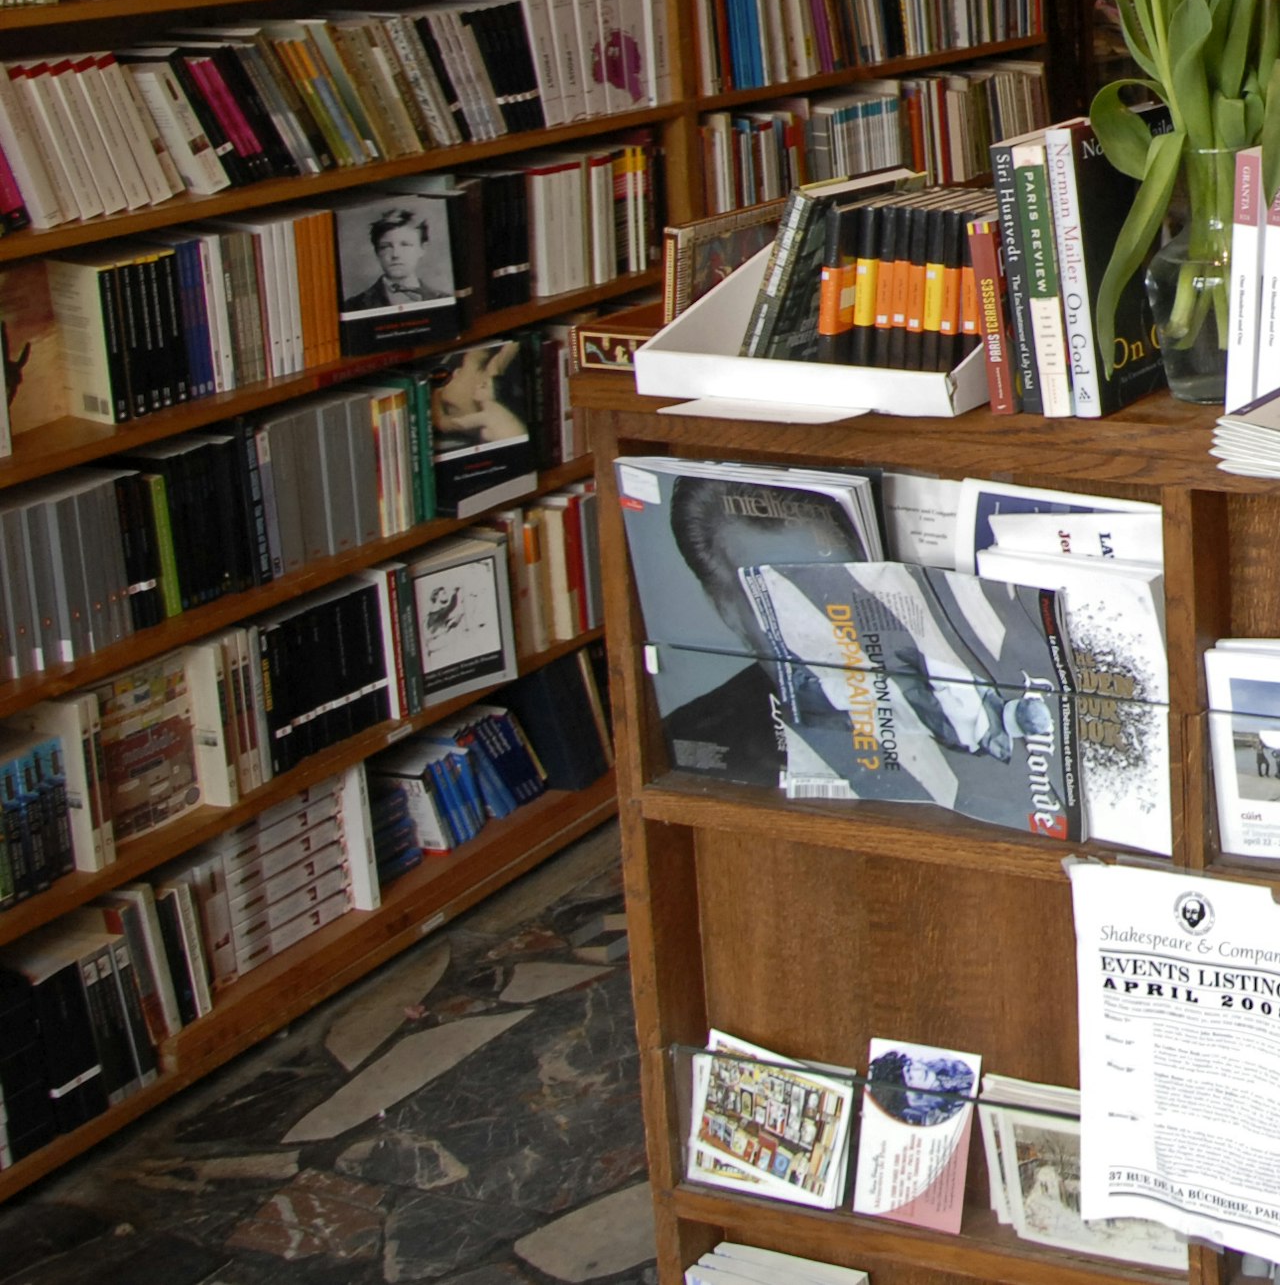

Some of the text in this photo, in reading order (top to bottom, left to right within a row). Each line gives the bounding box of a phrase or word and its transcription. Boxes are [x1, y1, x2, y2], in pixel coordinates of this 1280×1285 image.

[996, 153, 1011, 184] Siri
[1241, 165, 1251, 212] GRANTA
[1000, 188, 1021, 263] Hustvedt
[1023, 171, 1047, 293] PARIS REVIEW
[1053, 141, 1090, 377] Norman Mailer On God
[1112, 335, 1145, 370] On
[827, 603, 879, 750] DISPARAÎTRE
[876, 706, 901, 772] ENCORE
[1026, 731, 1056, 829] Monde
[1099, 925, 1192, 953] Shakespeare
[1197, 938, 1214, 954] &
[1100, 954, 1190, 983] EVENTS
[1102, 977, 1199, 1004] APRIL
[1108, 1170, 1122, 1181] 37
[1126, 1172, 1152, 1185] RUE
[1153, 1178, 1169, 1192] DE
[1170, 1183, 1185, 1197] LA
